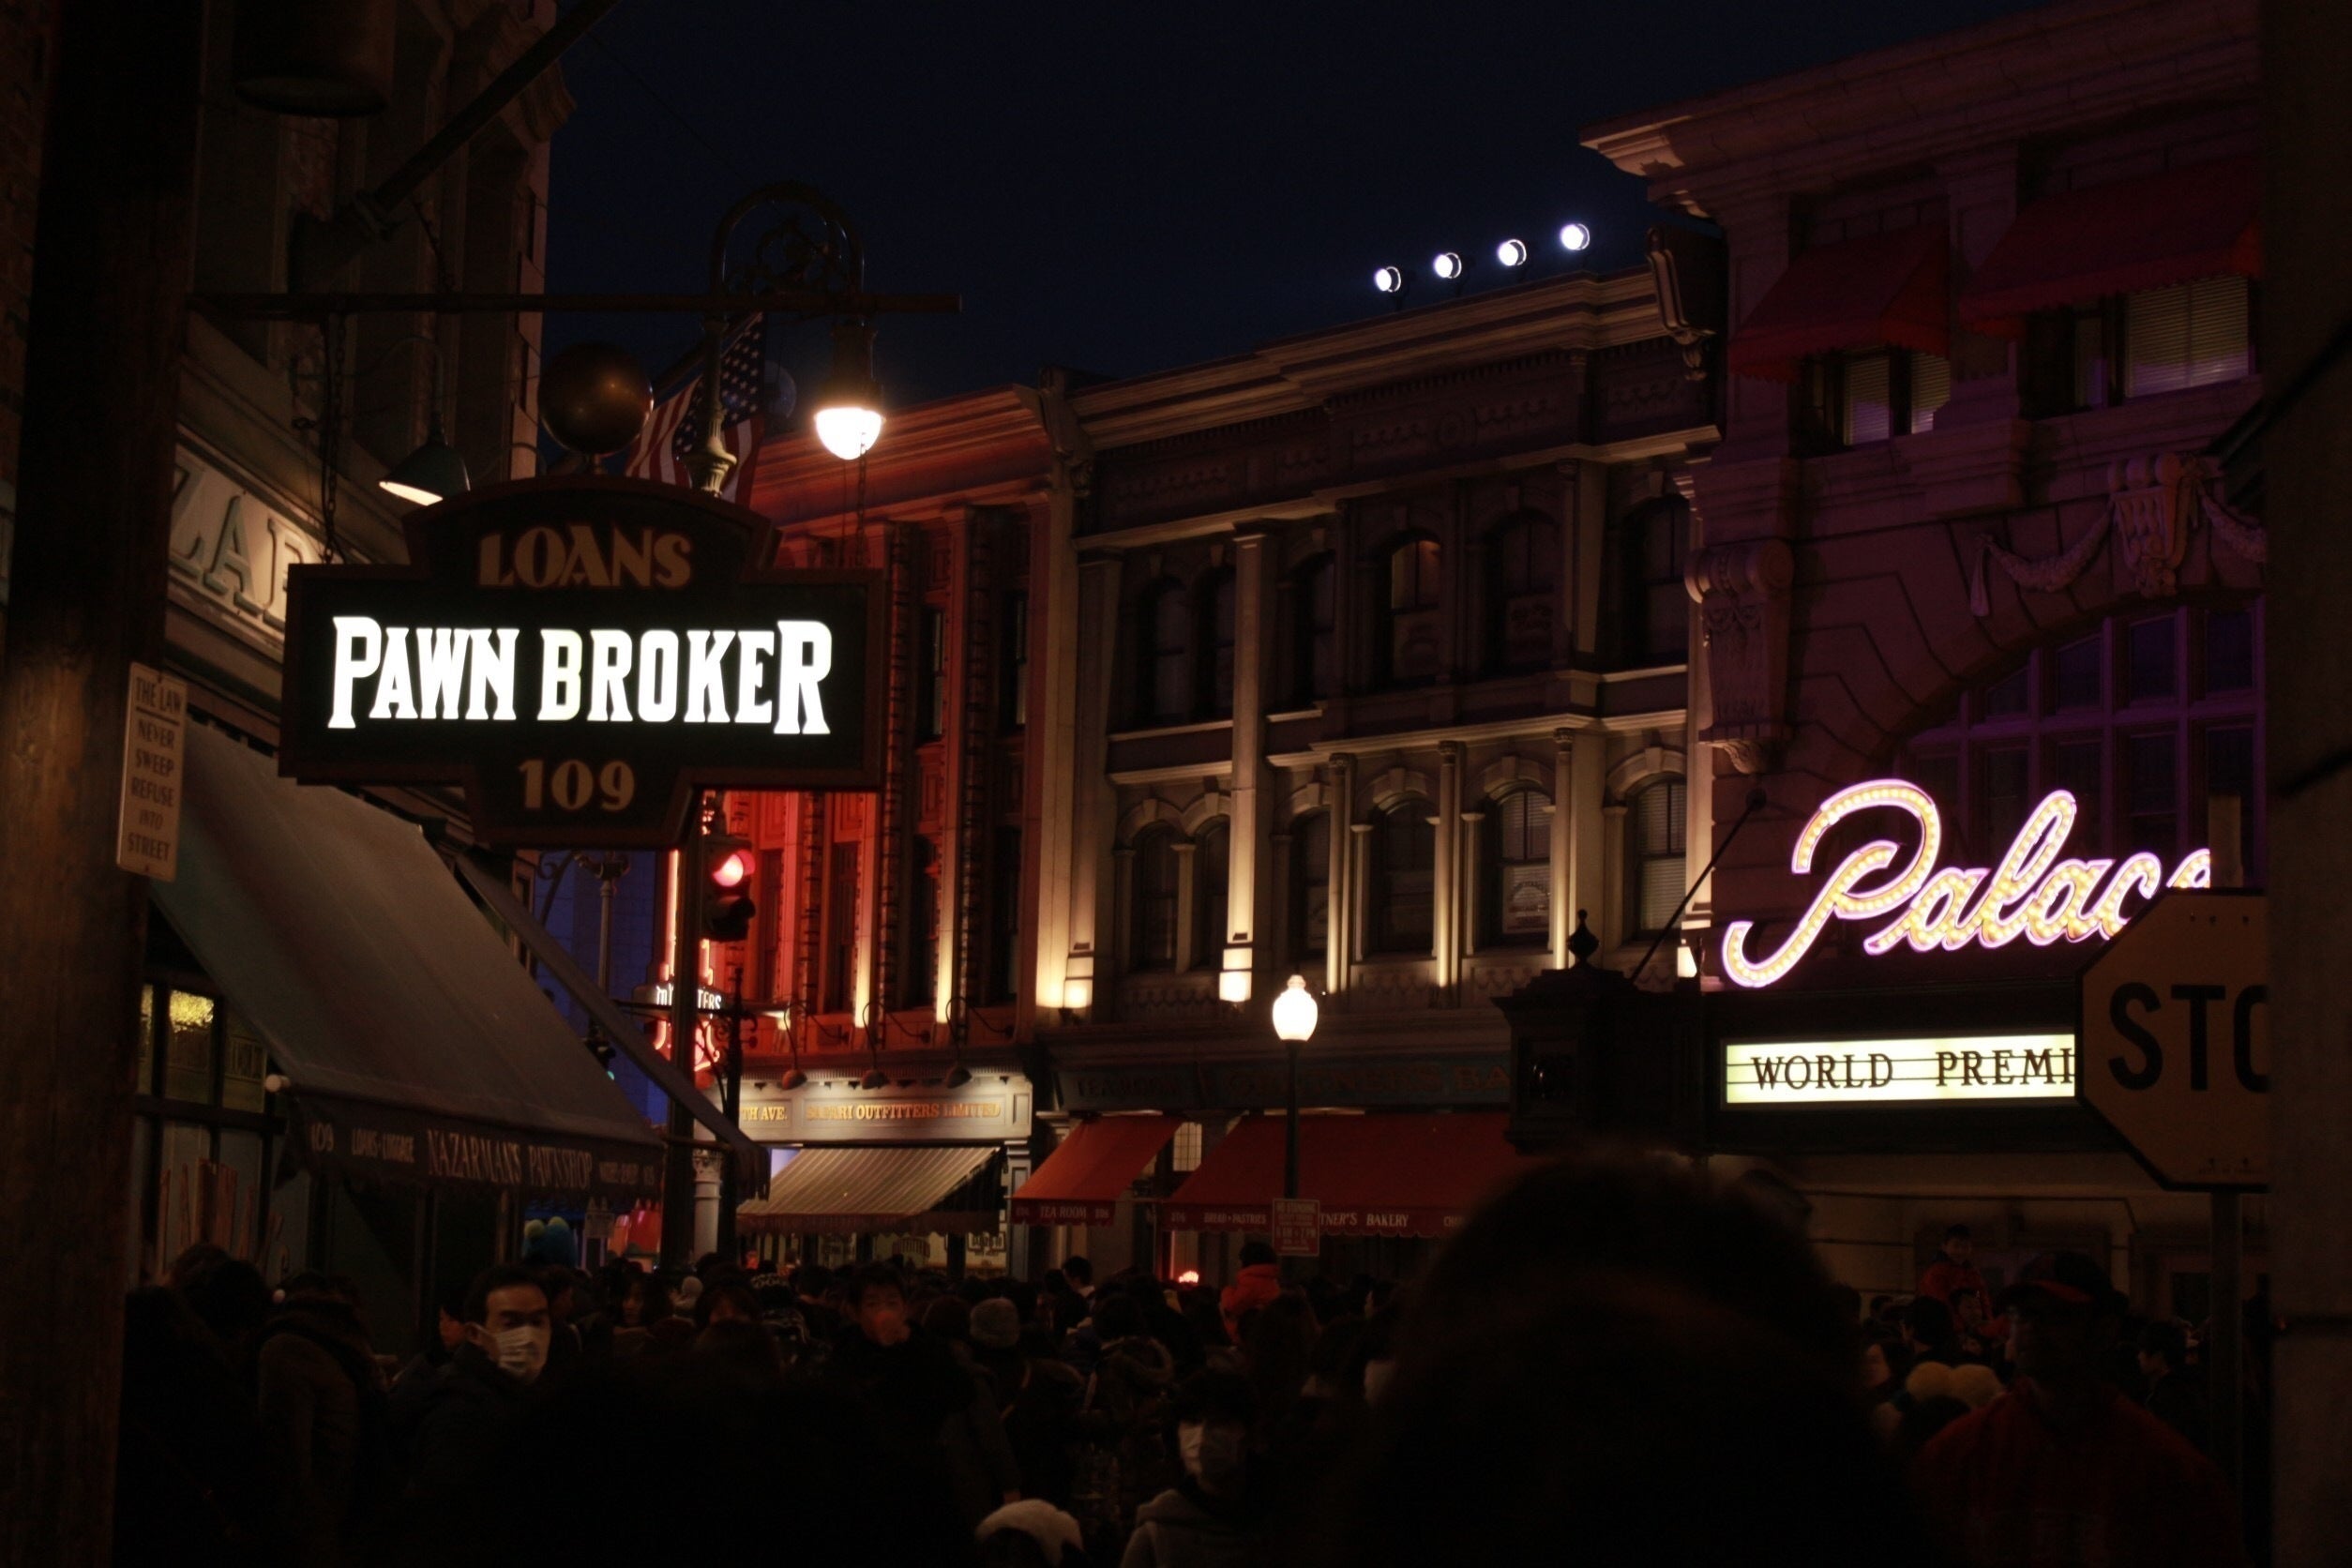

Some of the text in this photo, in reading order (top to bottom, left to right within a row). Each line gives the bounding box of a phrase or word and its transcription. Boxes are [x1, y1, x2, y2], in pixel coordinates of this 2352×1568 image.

[479, 525, 693, 589] LOANS
[327, 615, 833, 735] PAWN BROKER
[136, 676, 181, 715] THE LAW
[138, 718, 174, 750] NEVER
[135, 747, 174, 777] SWEEP
[131, 776, 174, 807] REFUSE
[519, 759, 636, 811] 109
[139, 808, 164, 831] INTO
[128, 832, 171, 861] STREET
[1752, 1048, 2074, 1092] WORLD PREMI
[761, 1105, 789, 1122] AVE.
[855, 1102, 940, 1122] OUTFITTERS
[1039, 1205, 1057, 1219] TEA
[1059, 1205, 1088, 1219] ROOM
[1365, 1214, 1410, 1228] BAKERY
